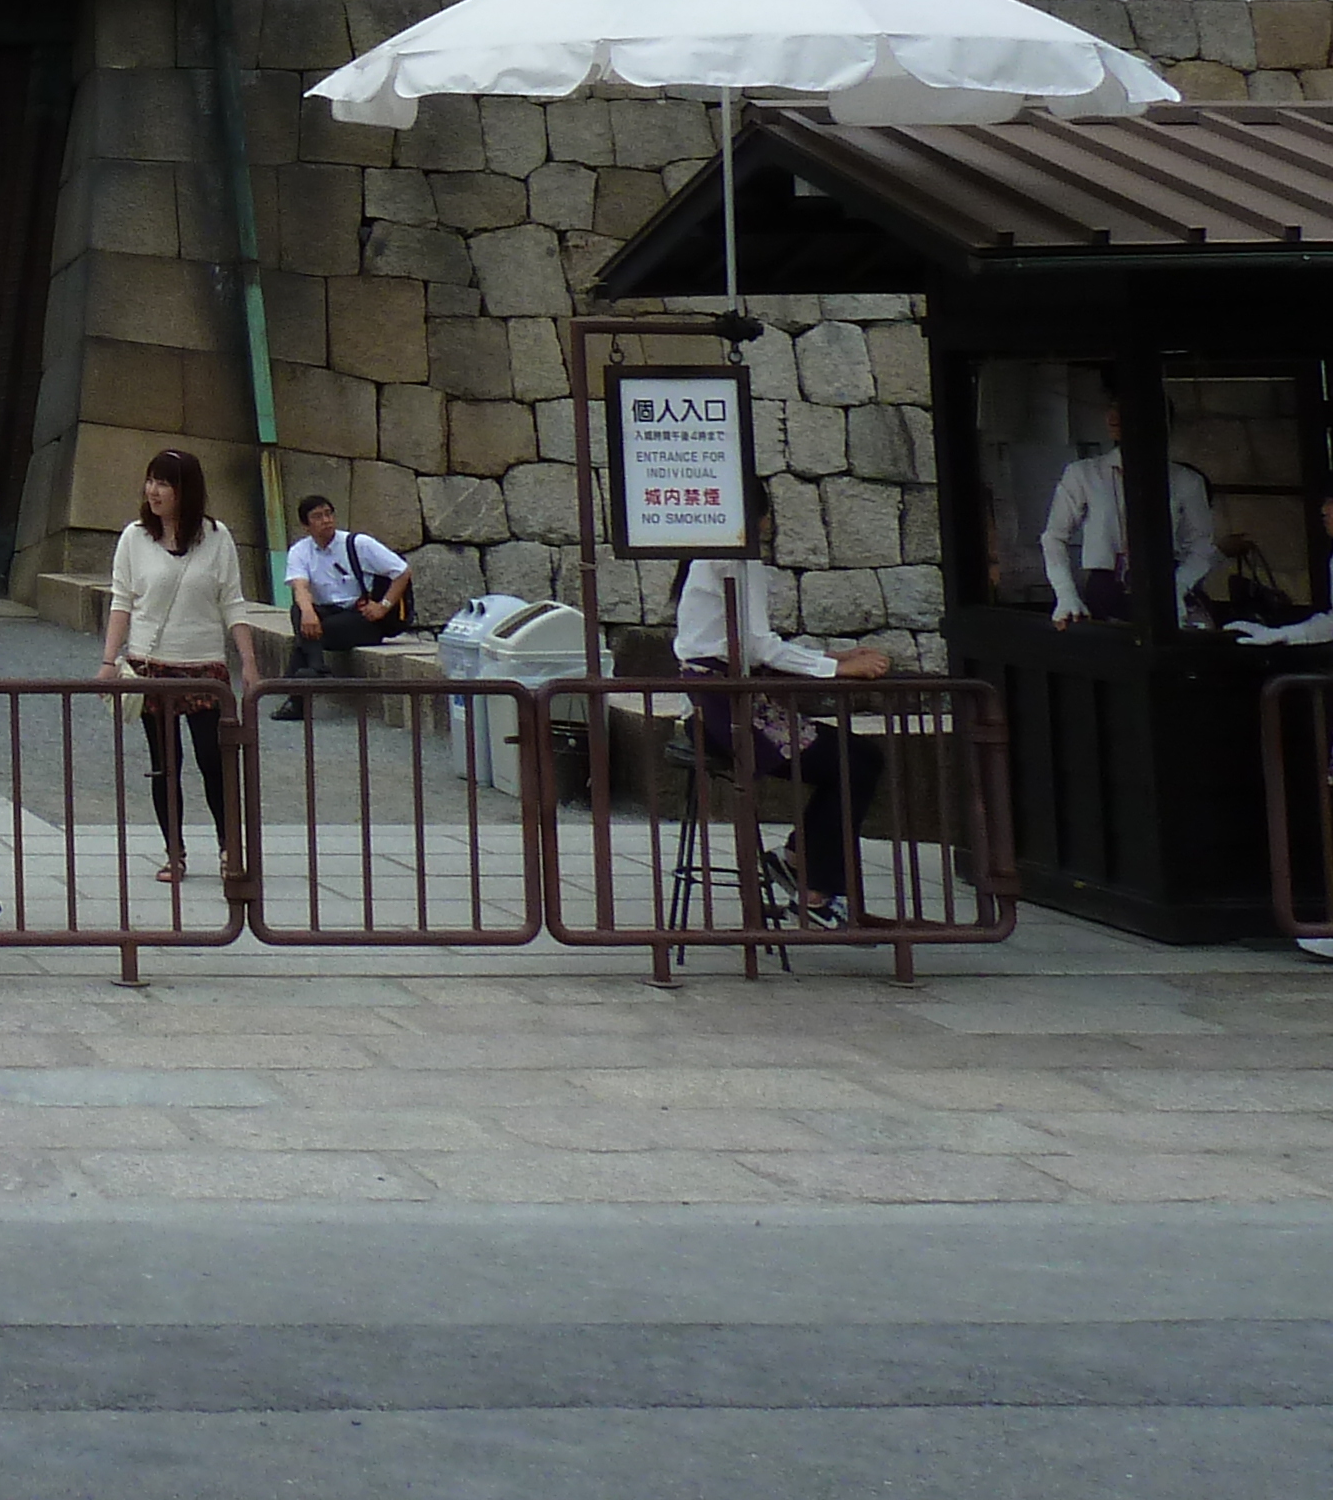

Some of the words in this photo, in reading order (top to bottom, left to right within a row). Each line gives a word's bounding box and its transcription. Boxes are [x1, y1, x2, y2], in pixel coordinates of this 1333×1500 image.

[632, 398, 726, 423] 個人入口
[636, 451, 697, 463] ENTRANCE
[702, 451, 725, 462] FOR
[646, 467, 717, 479] INDIVIDUAL
[644, 488, 720, 506] 城内禁煙
[642, 513, 660, 524] NO
[665, 513, 726, 525] SMOKING
